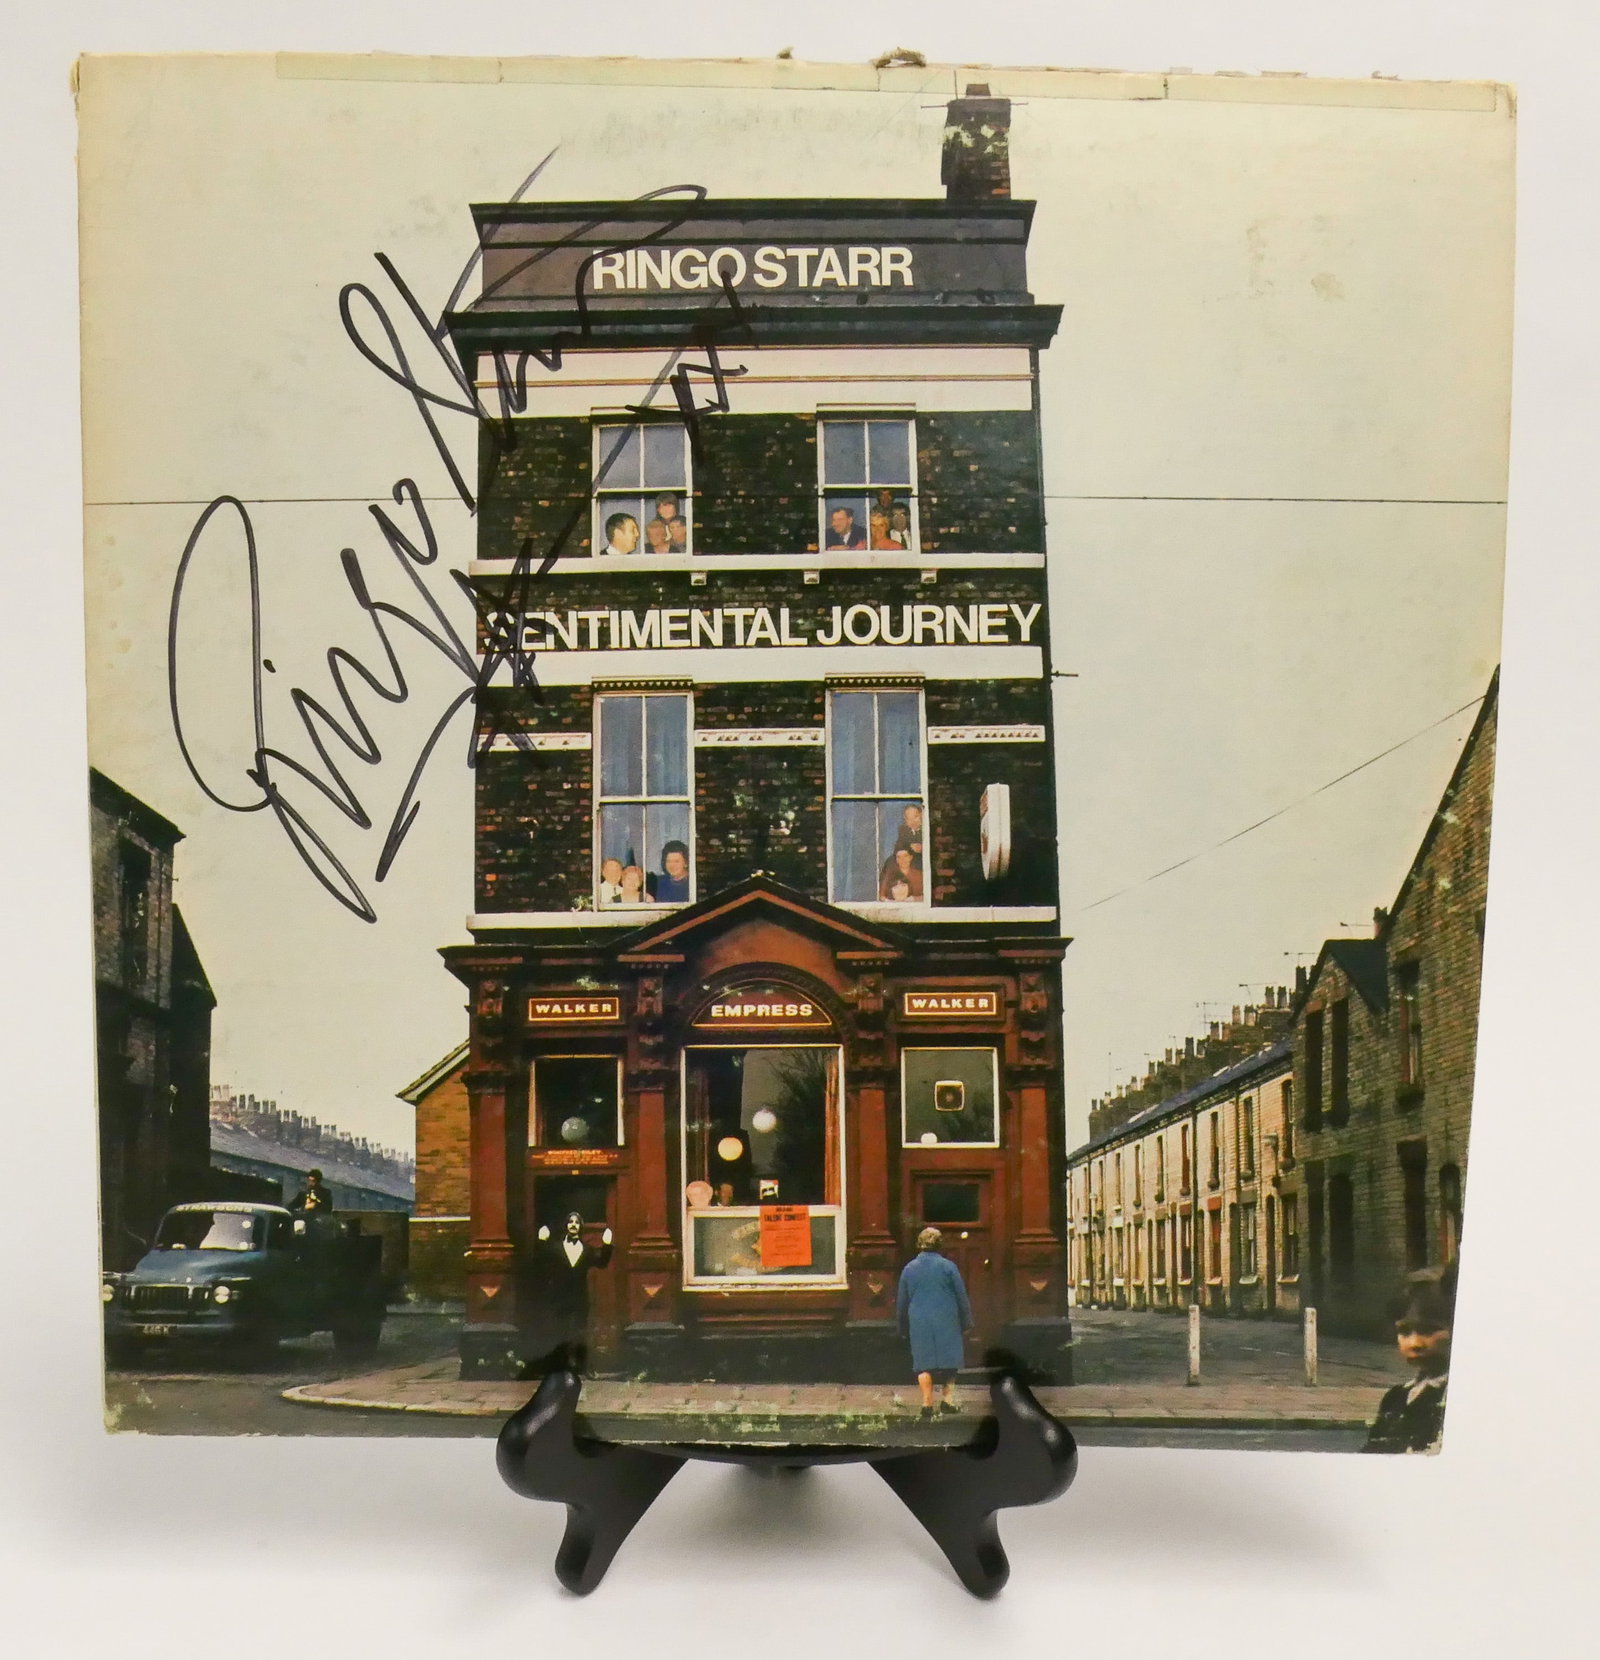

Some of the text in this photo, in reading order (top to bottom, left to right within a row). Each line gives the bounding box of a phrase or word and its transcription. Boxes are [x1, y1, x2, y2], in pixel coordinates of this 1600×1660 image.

[593, 245, 914, 290] RINGO STARR
[817, 603, 1042, 646] JOURNEY
[535, 1003, 612, 1014] WALKER
[710, 1003, 813, 1018] EMPRESS
[911, 998, 989, 1009] WALKER
